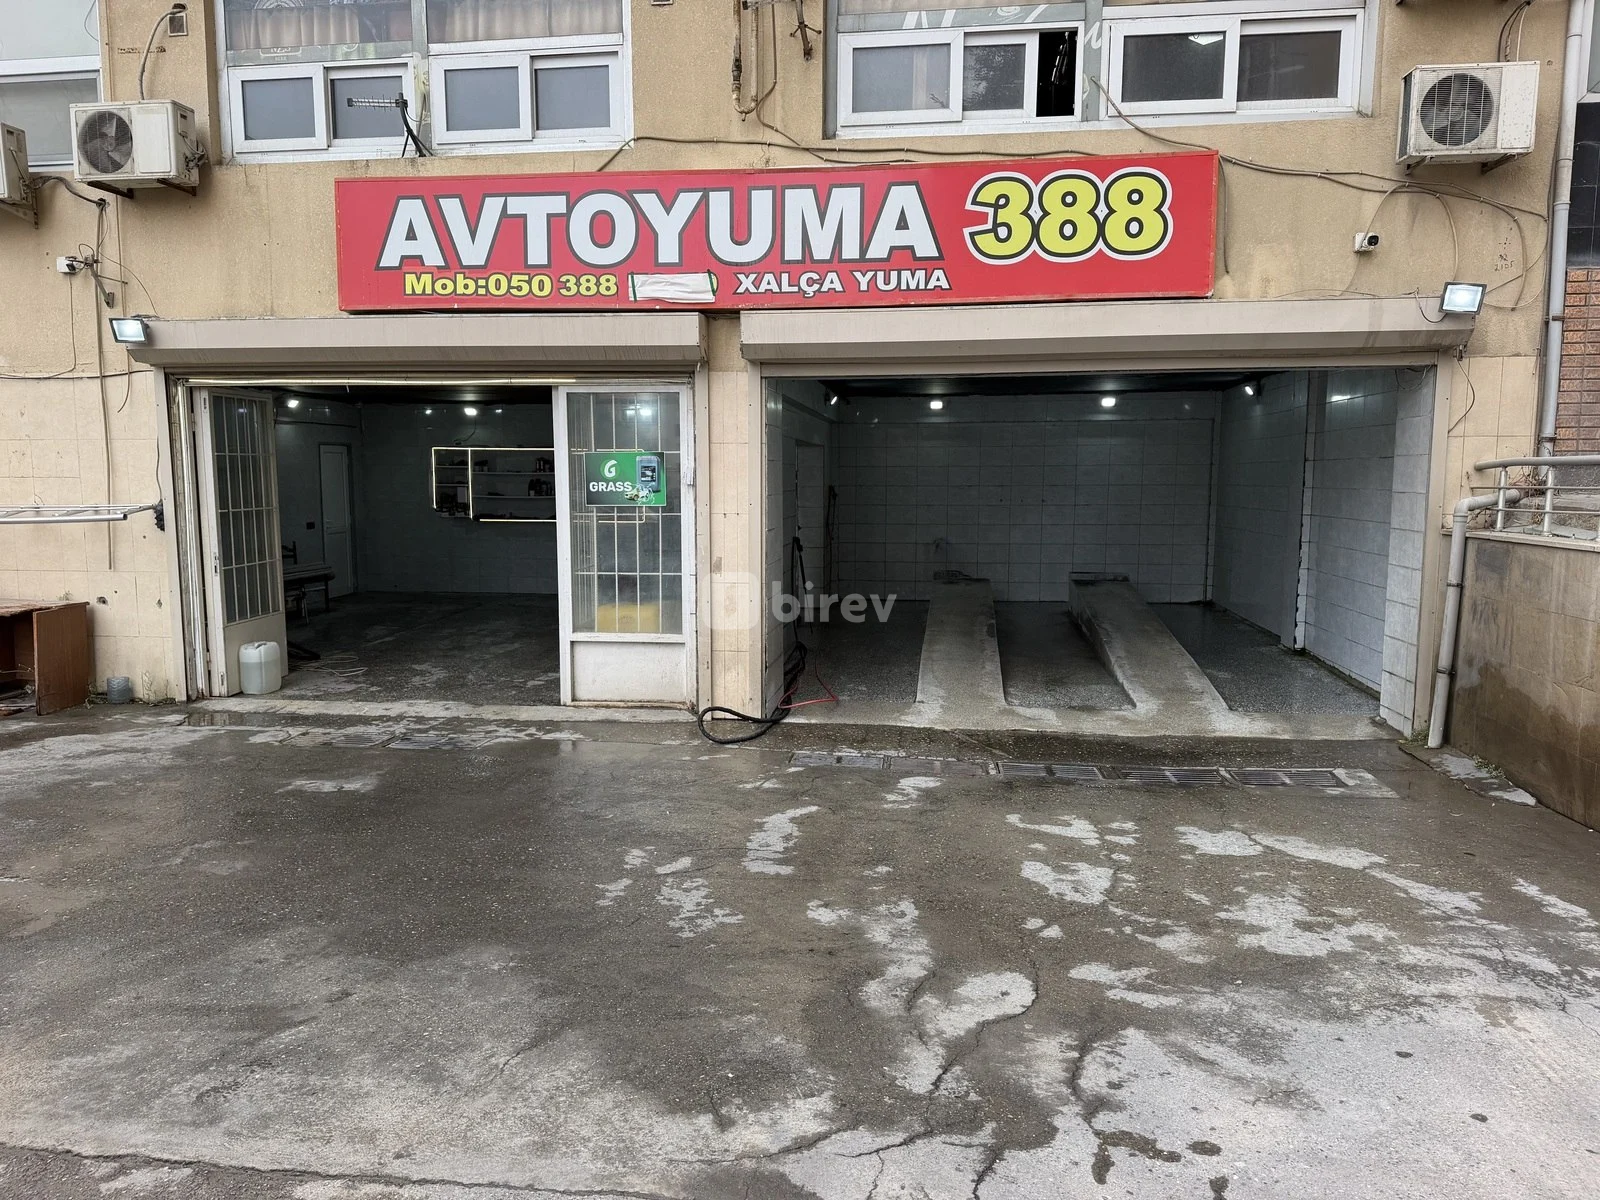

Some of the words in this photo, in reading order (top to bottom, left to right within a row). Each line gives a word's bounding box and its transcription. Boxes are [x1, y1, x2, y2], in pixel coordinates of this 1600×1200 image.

[377, 183, 942, 270] AVTOYUMA
[965, 168, 1172, 265] 388
[405, 272, 552, 297] Mob:050
[558, 272, 618, 297] 388
[734, 271, 841, 297] XALÇA
[850, 269, 952, 292] YUMA
[589, 481, 633, 492] GRASS
